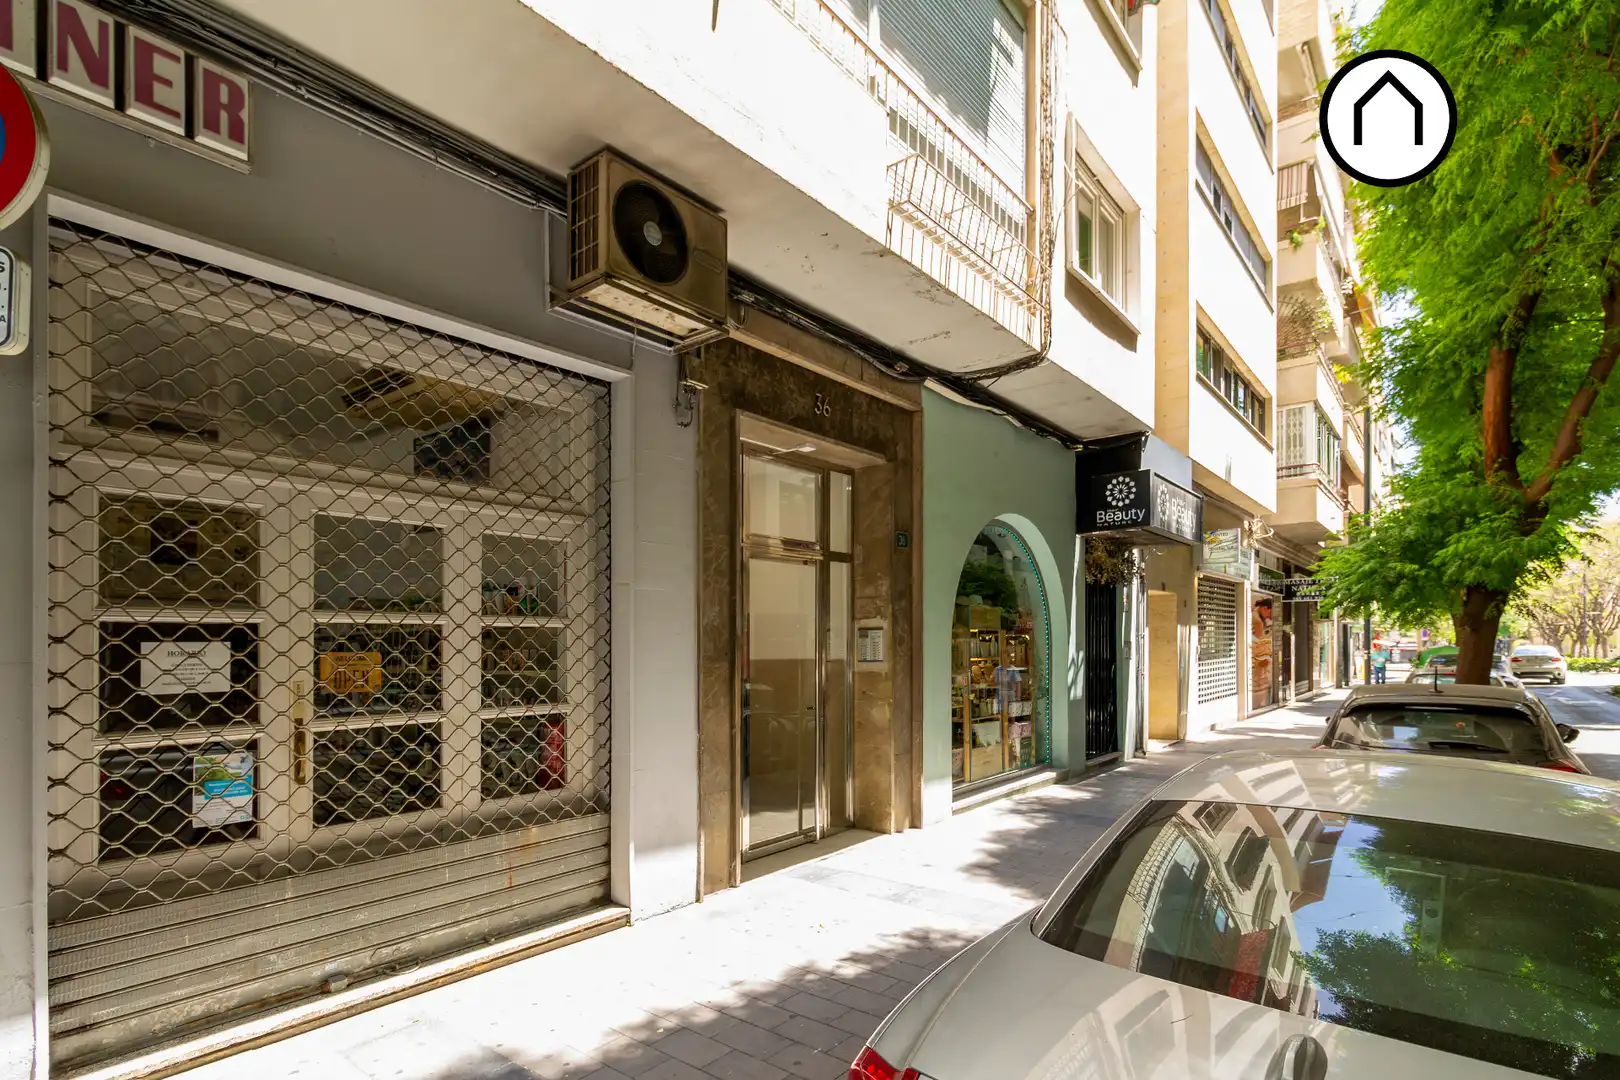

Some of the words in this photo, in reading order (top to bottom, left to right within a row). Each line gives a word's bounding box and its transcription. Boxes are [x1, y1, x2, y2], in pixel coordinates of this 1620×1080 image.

[814, 393, 831, 417] 36
[1096, 508, 1146, 522] Beauty
[1171, 498, 1197, 533] Beauty
[898, 535, 907, 546] 36
[333, 669, 369, 690] OPEN
